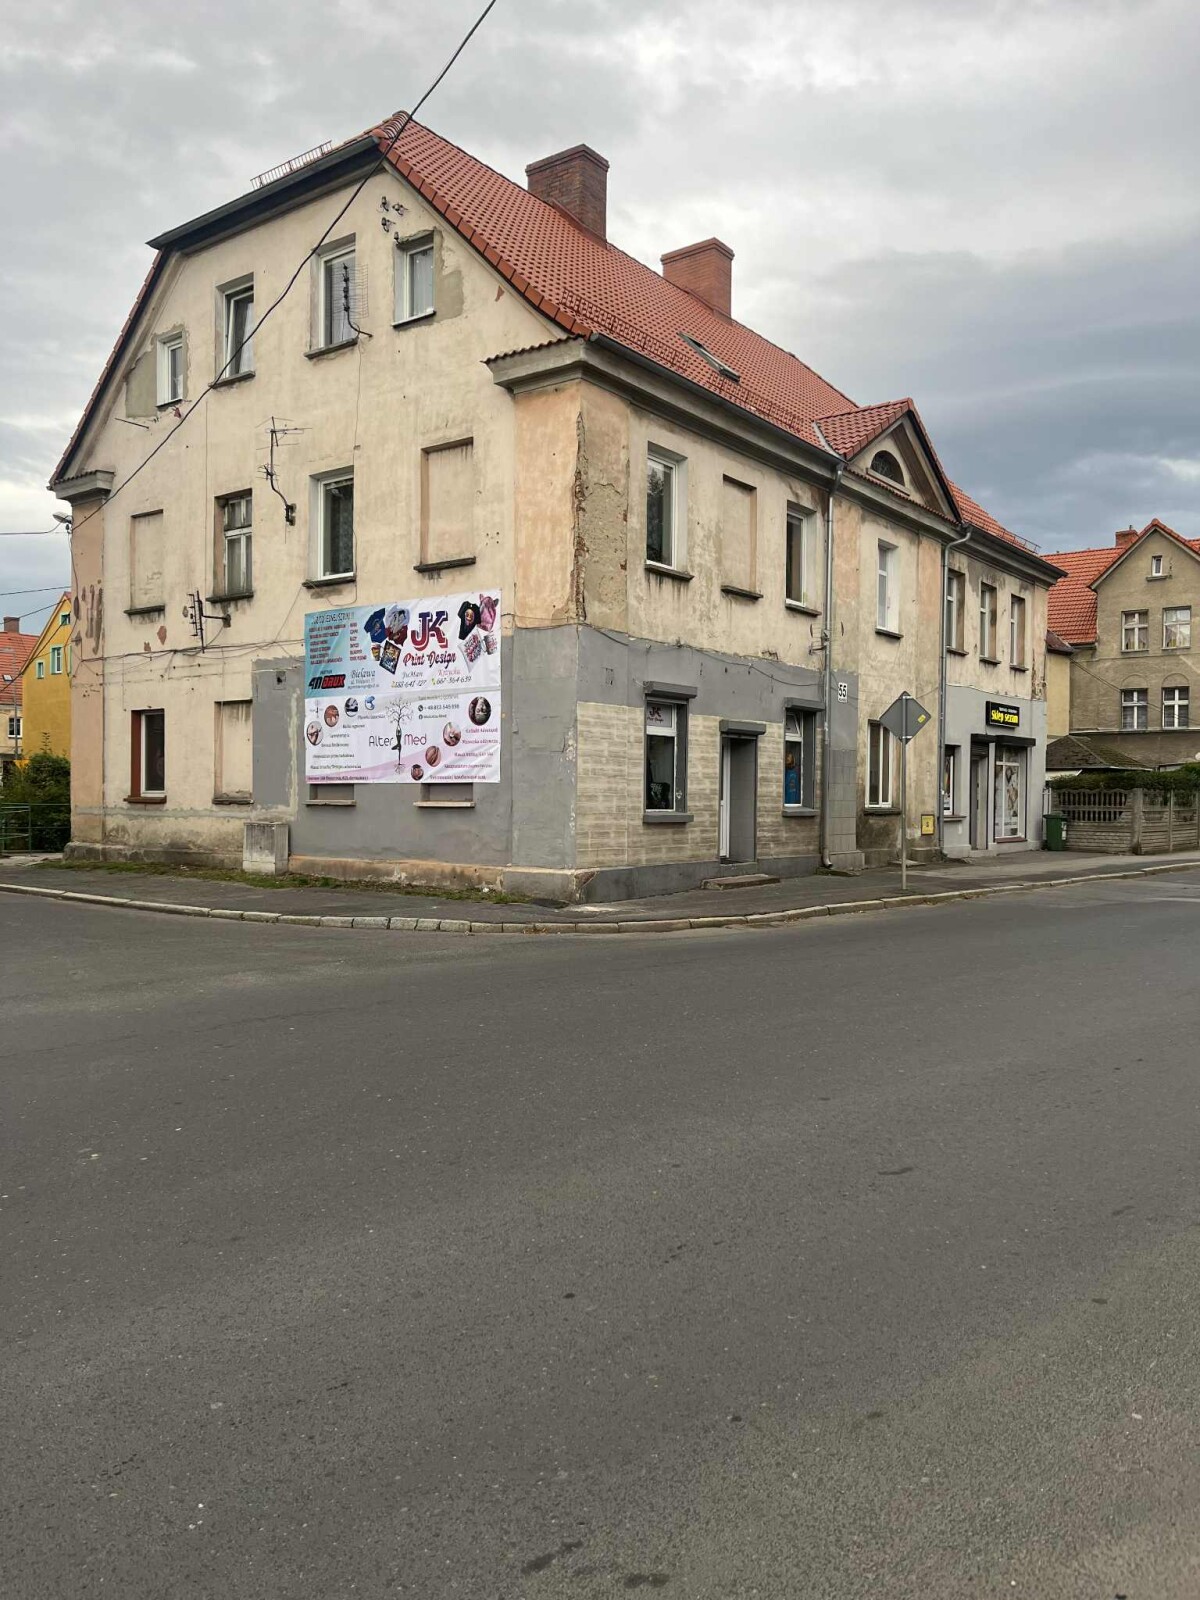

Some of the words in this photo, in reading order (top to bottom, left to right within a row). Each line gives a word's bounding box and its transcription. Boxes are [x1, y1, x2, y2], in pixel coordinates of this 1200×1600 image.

[411, 610, 448, 651] JK
[403, 652, 425, 666] Print
[427, 650, 456, 669] Design
[838, 684, 847, 697] 55
[991, 710, 1004, 723] Sklep
[369, 735, 394, 747] Alter
[404, 733, 427, 746] Med
